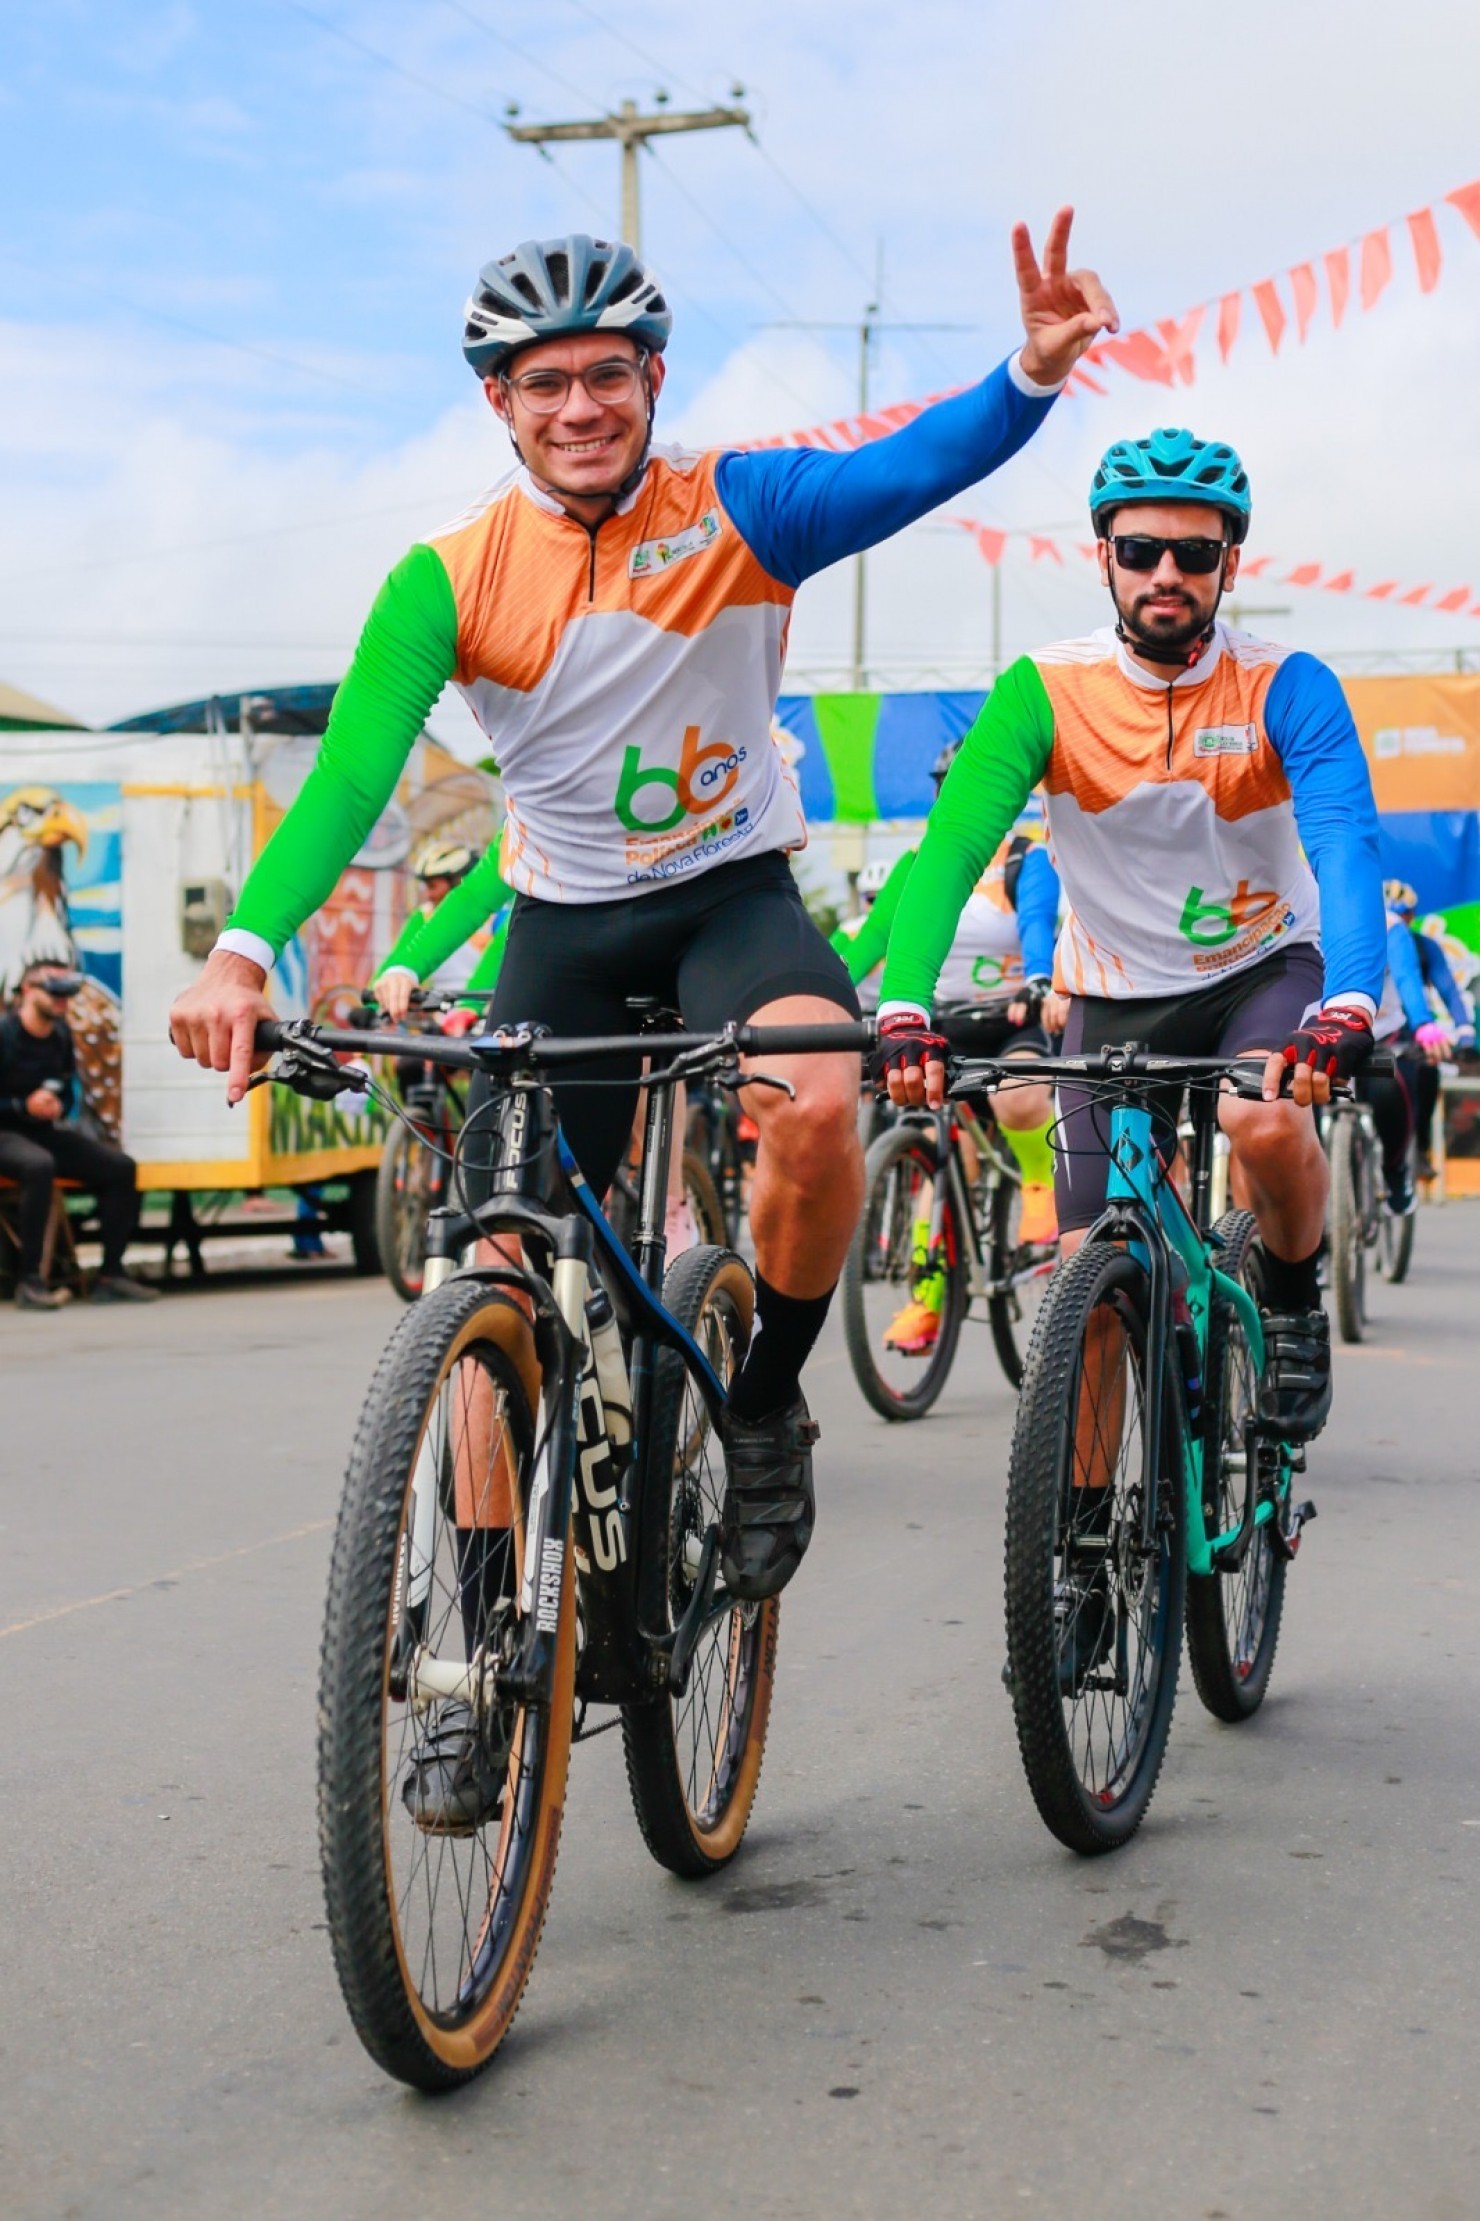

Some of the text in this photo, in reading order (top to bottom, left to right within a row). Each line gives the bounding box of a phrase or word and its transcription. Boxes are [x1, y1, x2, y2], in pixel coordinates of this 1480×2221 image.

[700, 746, 748, 787] anos
[652, 855, 694, 879] Nova
[505, 1092, 527, 1190] FOCUS
[536, 1537, 565, 1634] ROCKSHOX
